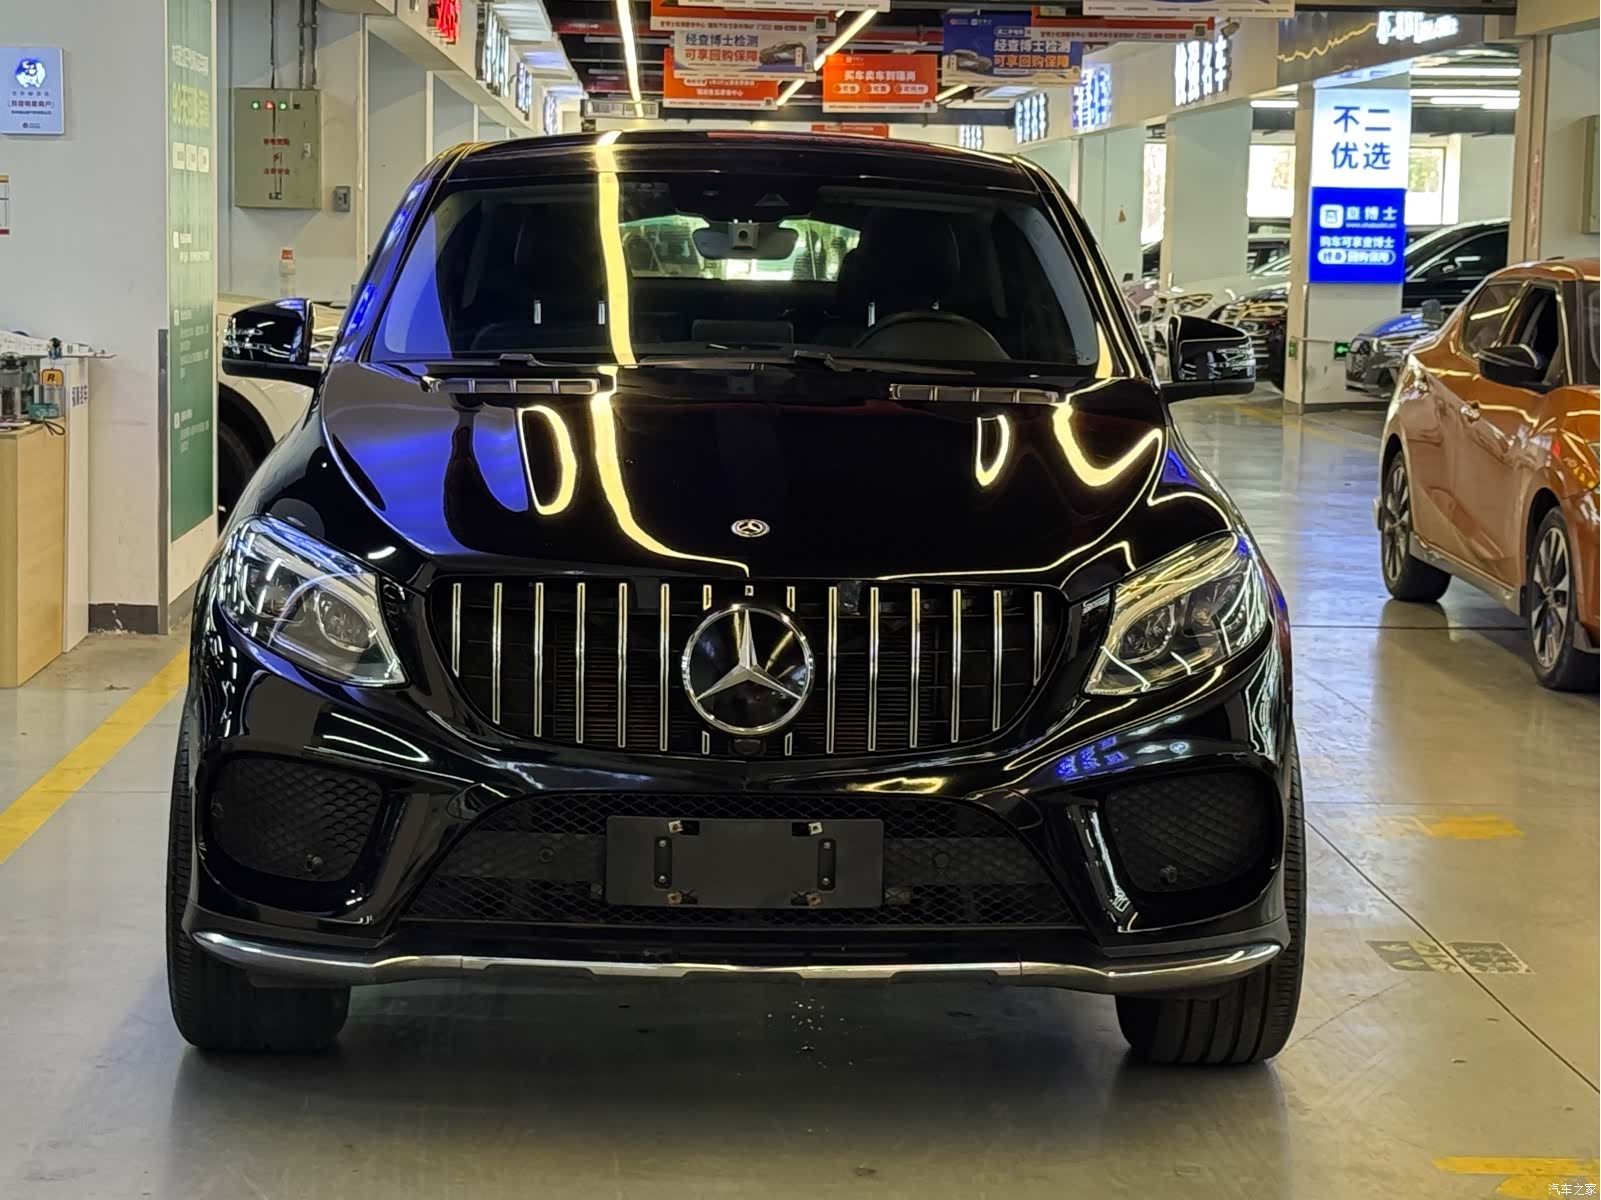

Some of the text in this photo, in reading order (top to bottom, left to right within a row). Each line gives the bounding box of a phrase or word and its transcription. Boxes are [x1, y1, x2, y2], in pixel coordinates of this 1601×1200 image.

[685, 34, 759, 48] 经查博士检测
[994, 39, 1071, 53] 经查博士检测
[685, 49, 758, 62] 可享回购保障
[993, 55, 1070, 68] 可享回购保障
[1333, 106, 1391, 132] 不二
[1331, 142, 1391, 170] 优选
